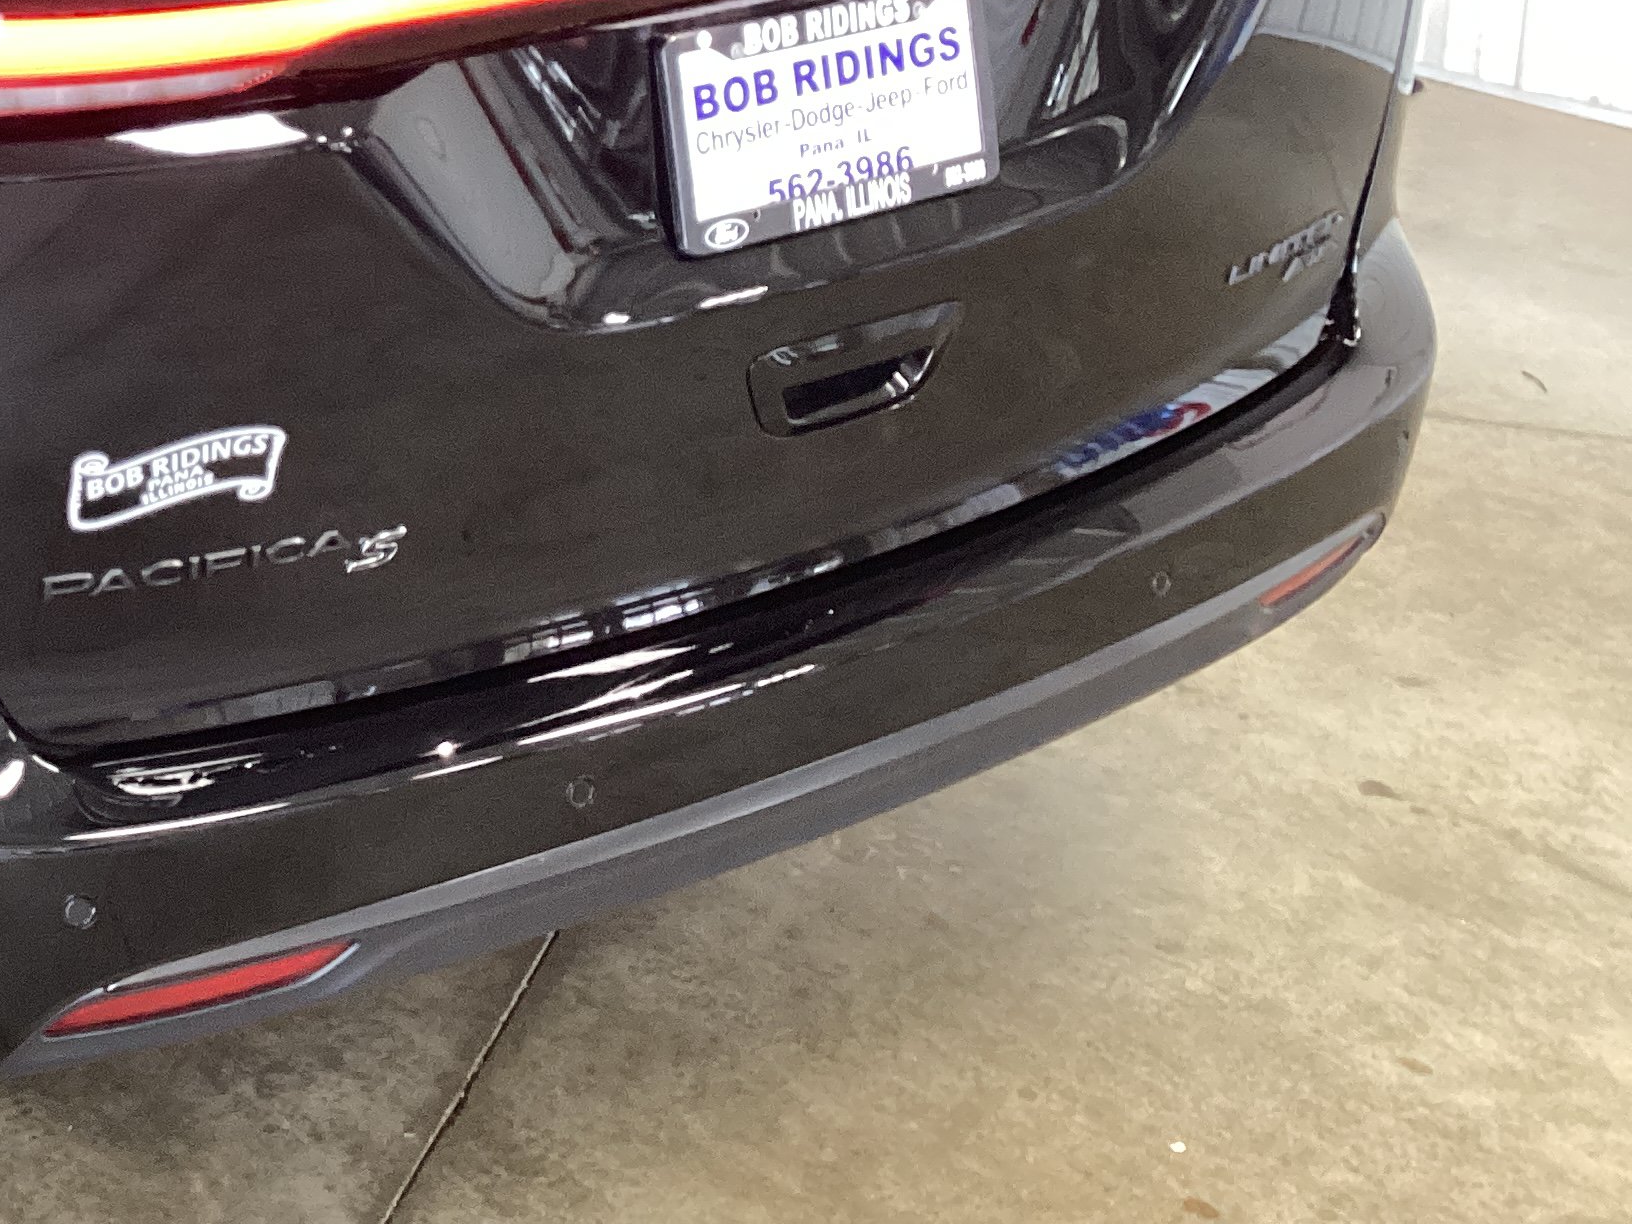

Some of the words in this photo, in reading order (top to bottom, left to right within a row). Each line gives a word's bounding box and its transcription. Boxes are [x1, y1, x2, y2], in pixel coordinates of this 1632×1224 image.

[743, 14, 799, 56] BOB
[693, 68, 779, 121] BOB
[792, 26, 961, 97] RIDINGS
[769, 145, 915, 202] 562-3986
[845, 171, 912, 217] ILLINOIS
[87, 464, 145, 500] BOB
[150, 433, 270, 477] RIDINGS
[140, 472, 215, 506] ILLINOIS
[42, 529, 352, 601] PACIFICA
